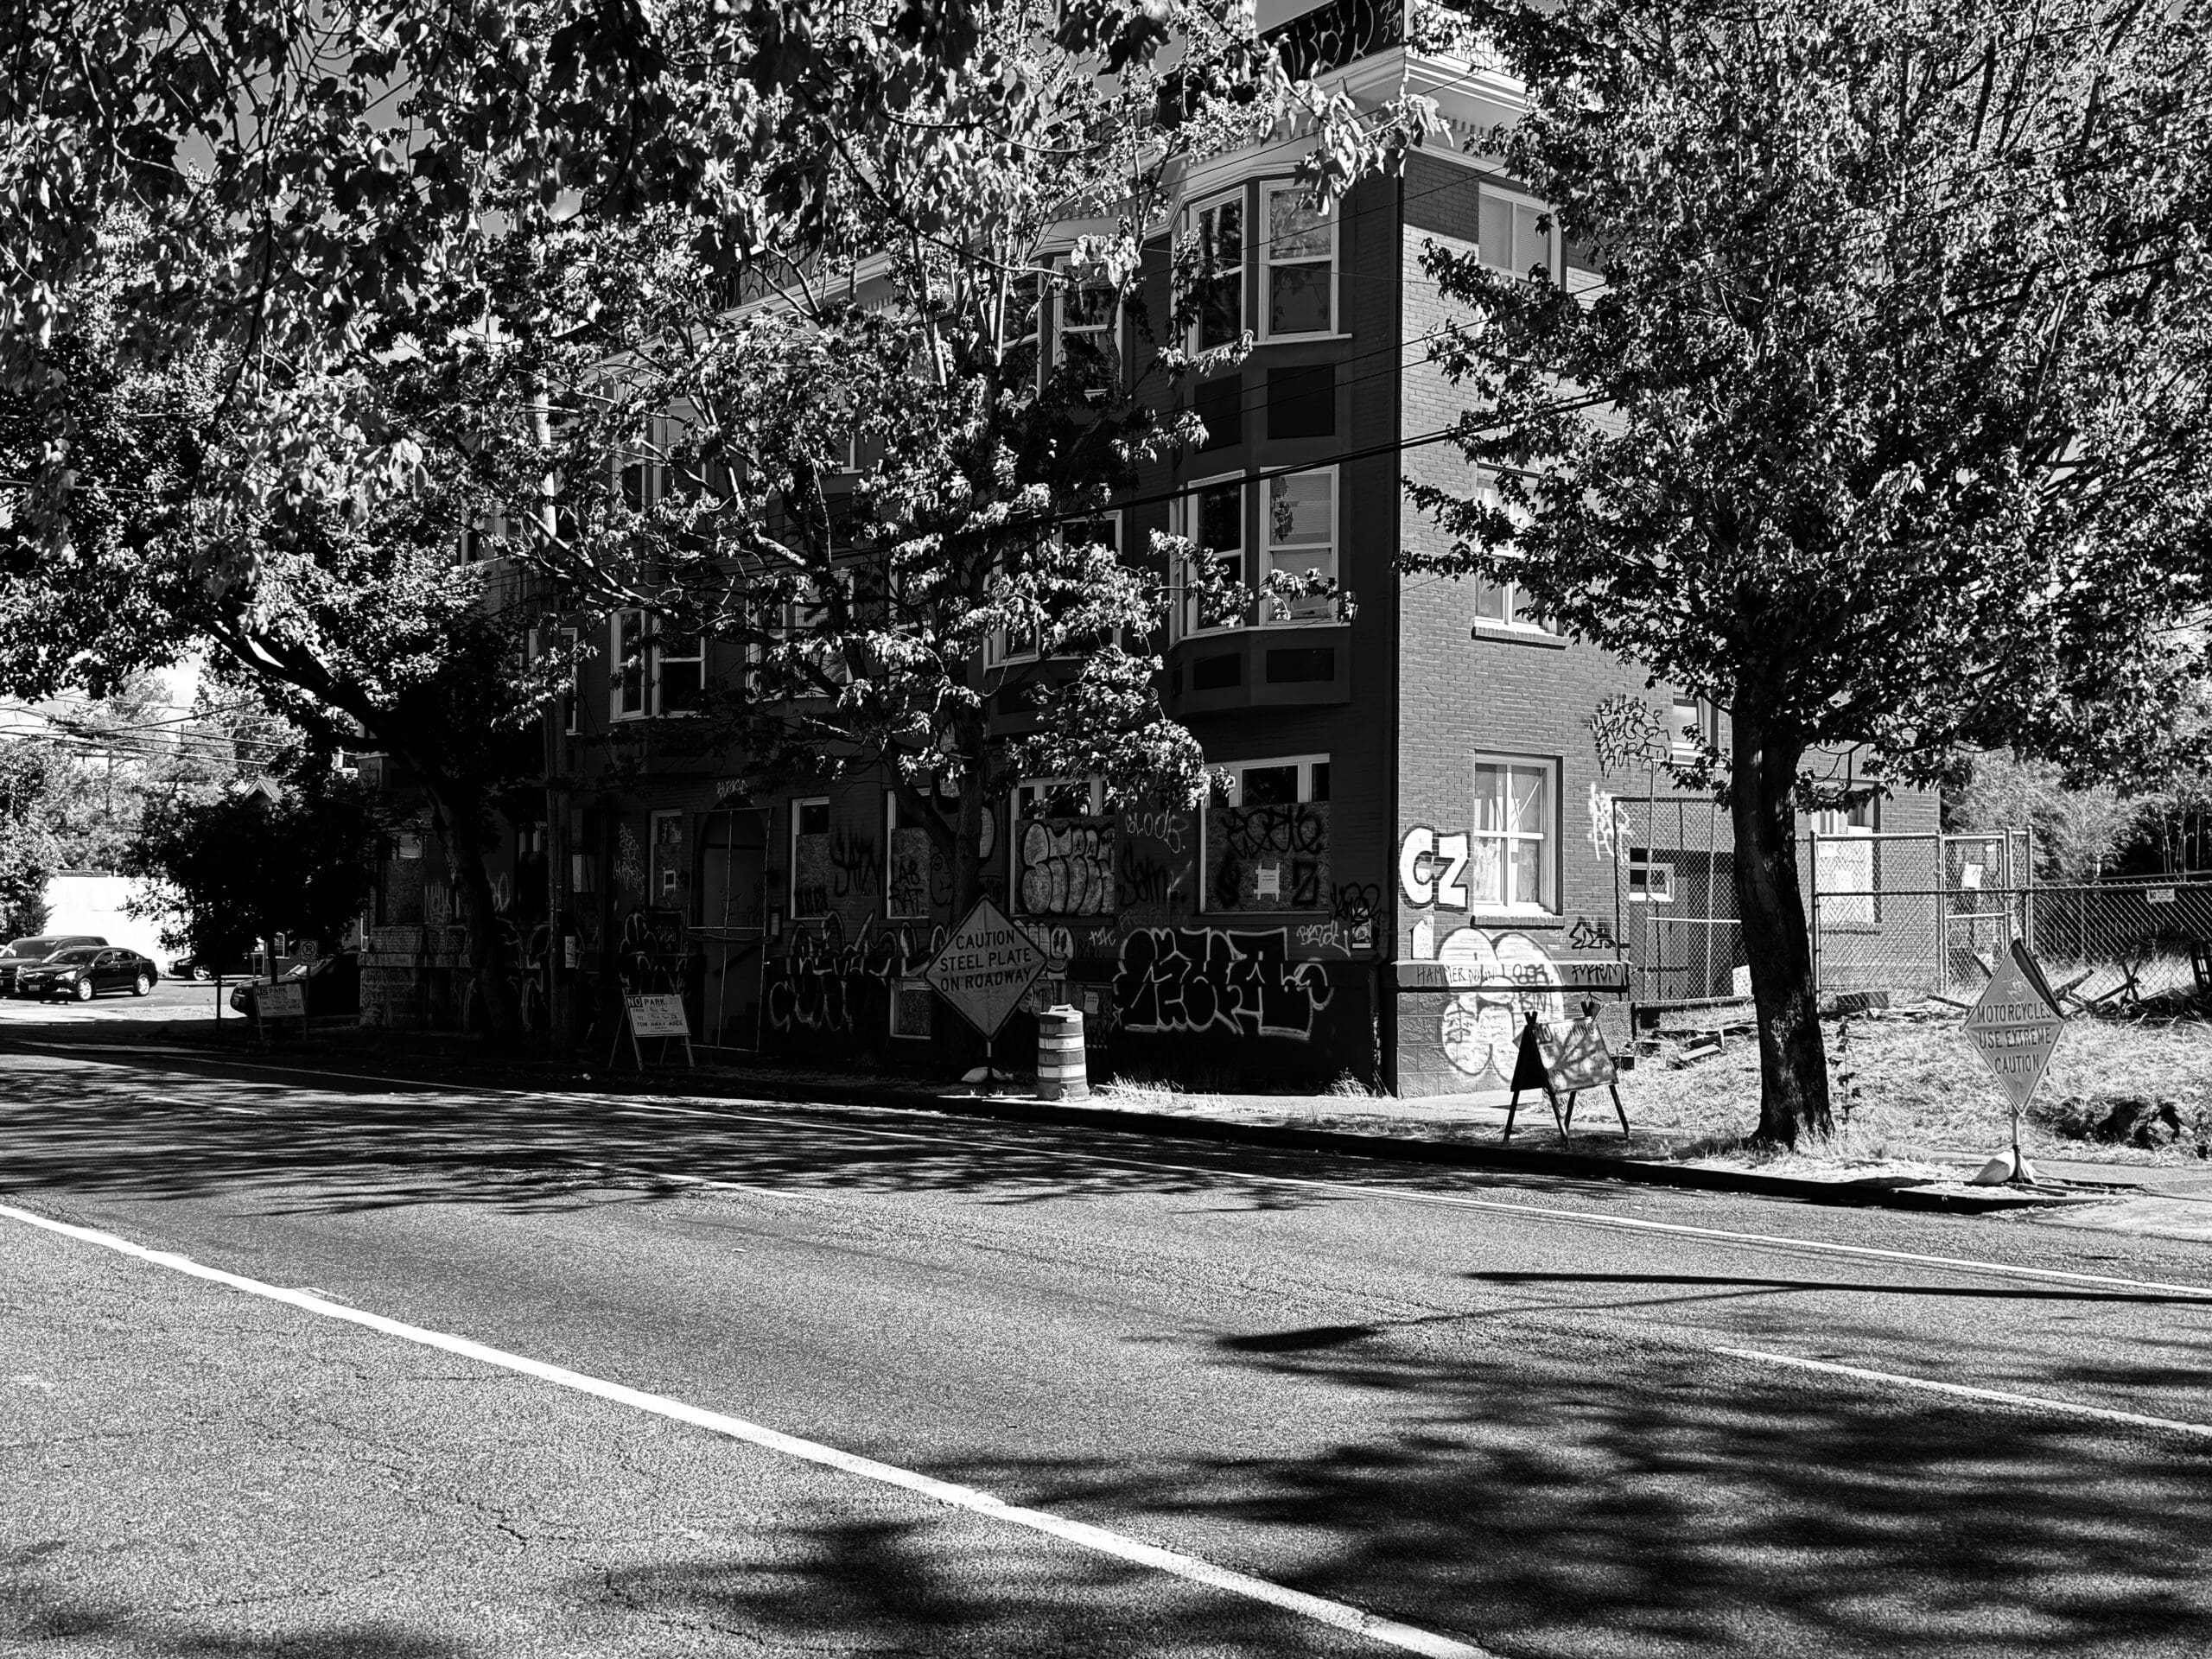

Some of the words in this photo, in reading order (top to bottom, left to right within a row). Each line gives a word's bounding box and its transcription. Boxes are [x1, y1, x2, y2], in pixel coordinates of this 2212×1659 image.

[1399, 825, 1470, 912] CZ
[956, 931, 1015, 950] CAUTION
[940, 953, 983, 972] STEEL
[988, 948, 1032, 967] PLATE
[940, 976, 960, 992] ON
[965, 968, 1033, 989] ROADWAY
[626, 996, 642, 1007] NO
[1977, 1002, 2052, 1023] MOTORCYCLES
[1979, 1031, 2002, 1049] USE
[2005, 1027, 2051, 1047] EXTREME
[1994, 1054, 2040, 1074] CAUTION
